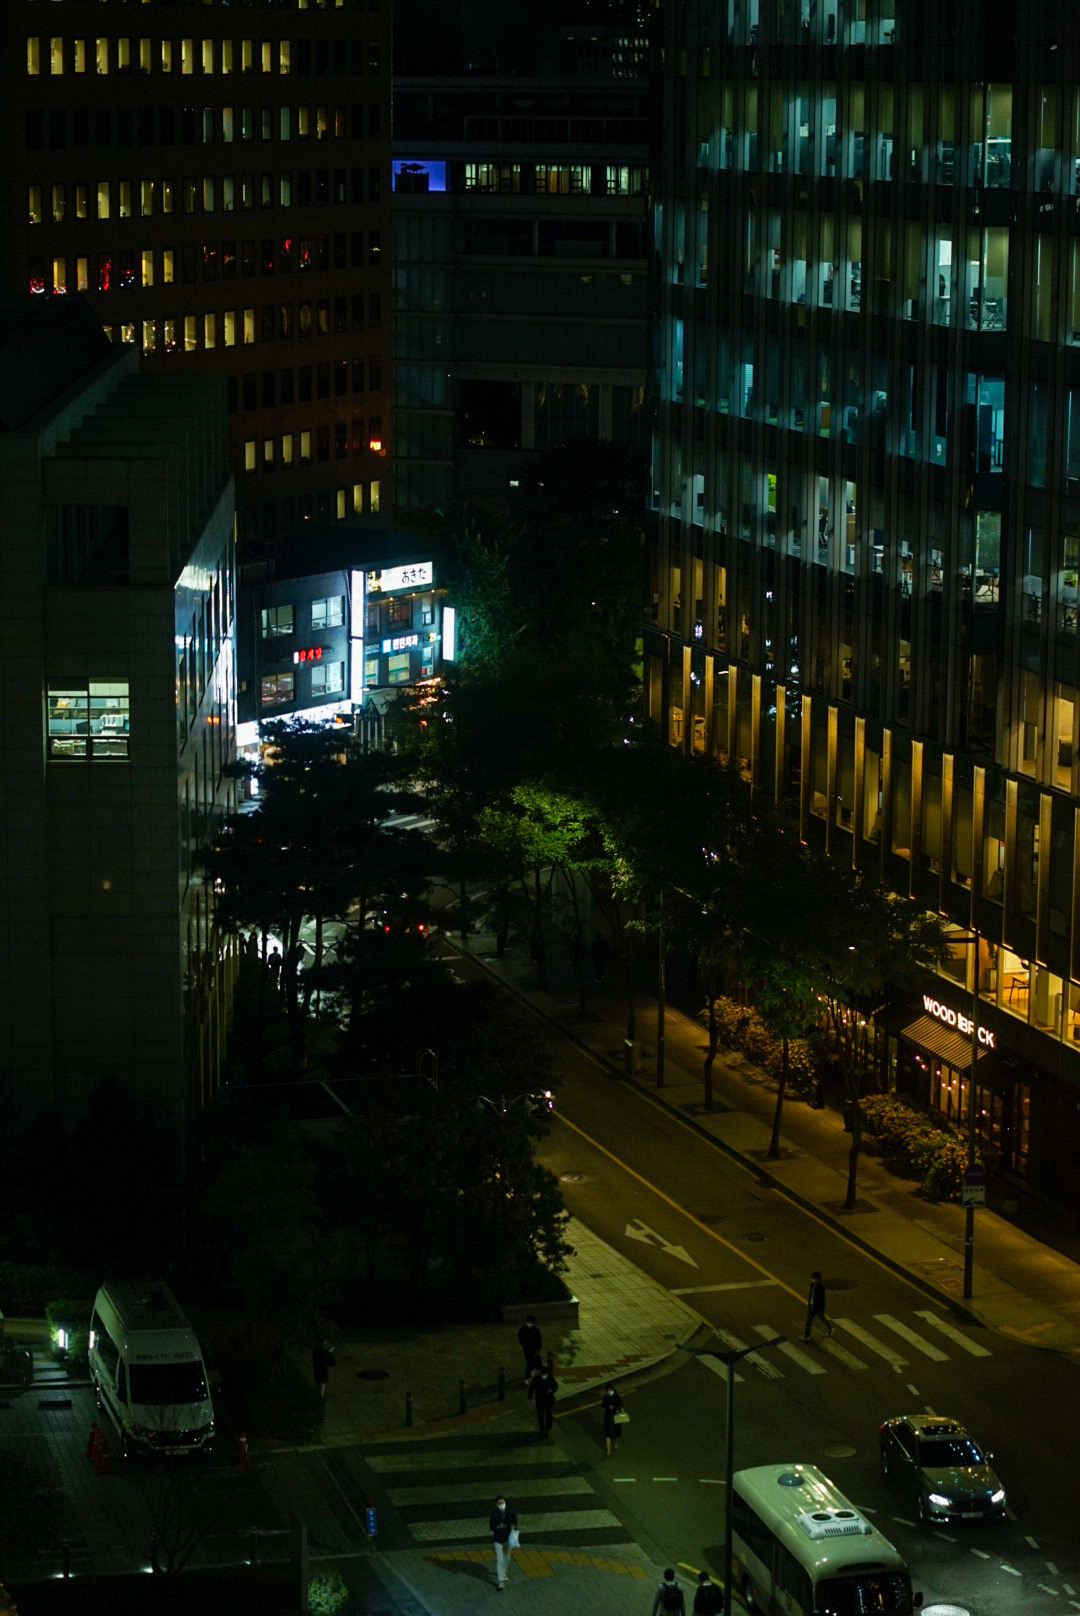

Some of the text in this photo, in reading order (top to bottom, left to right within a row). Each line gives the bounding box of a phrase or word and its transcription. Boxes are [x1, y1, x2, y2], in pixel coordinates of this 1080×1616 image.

[401, 567, 426, 584] あきた
[923, 994, 956, 1026] WOOD
[960, 1015, 995, 1048] BRCK
